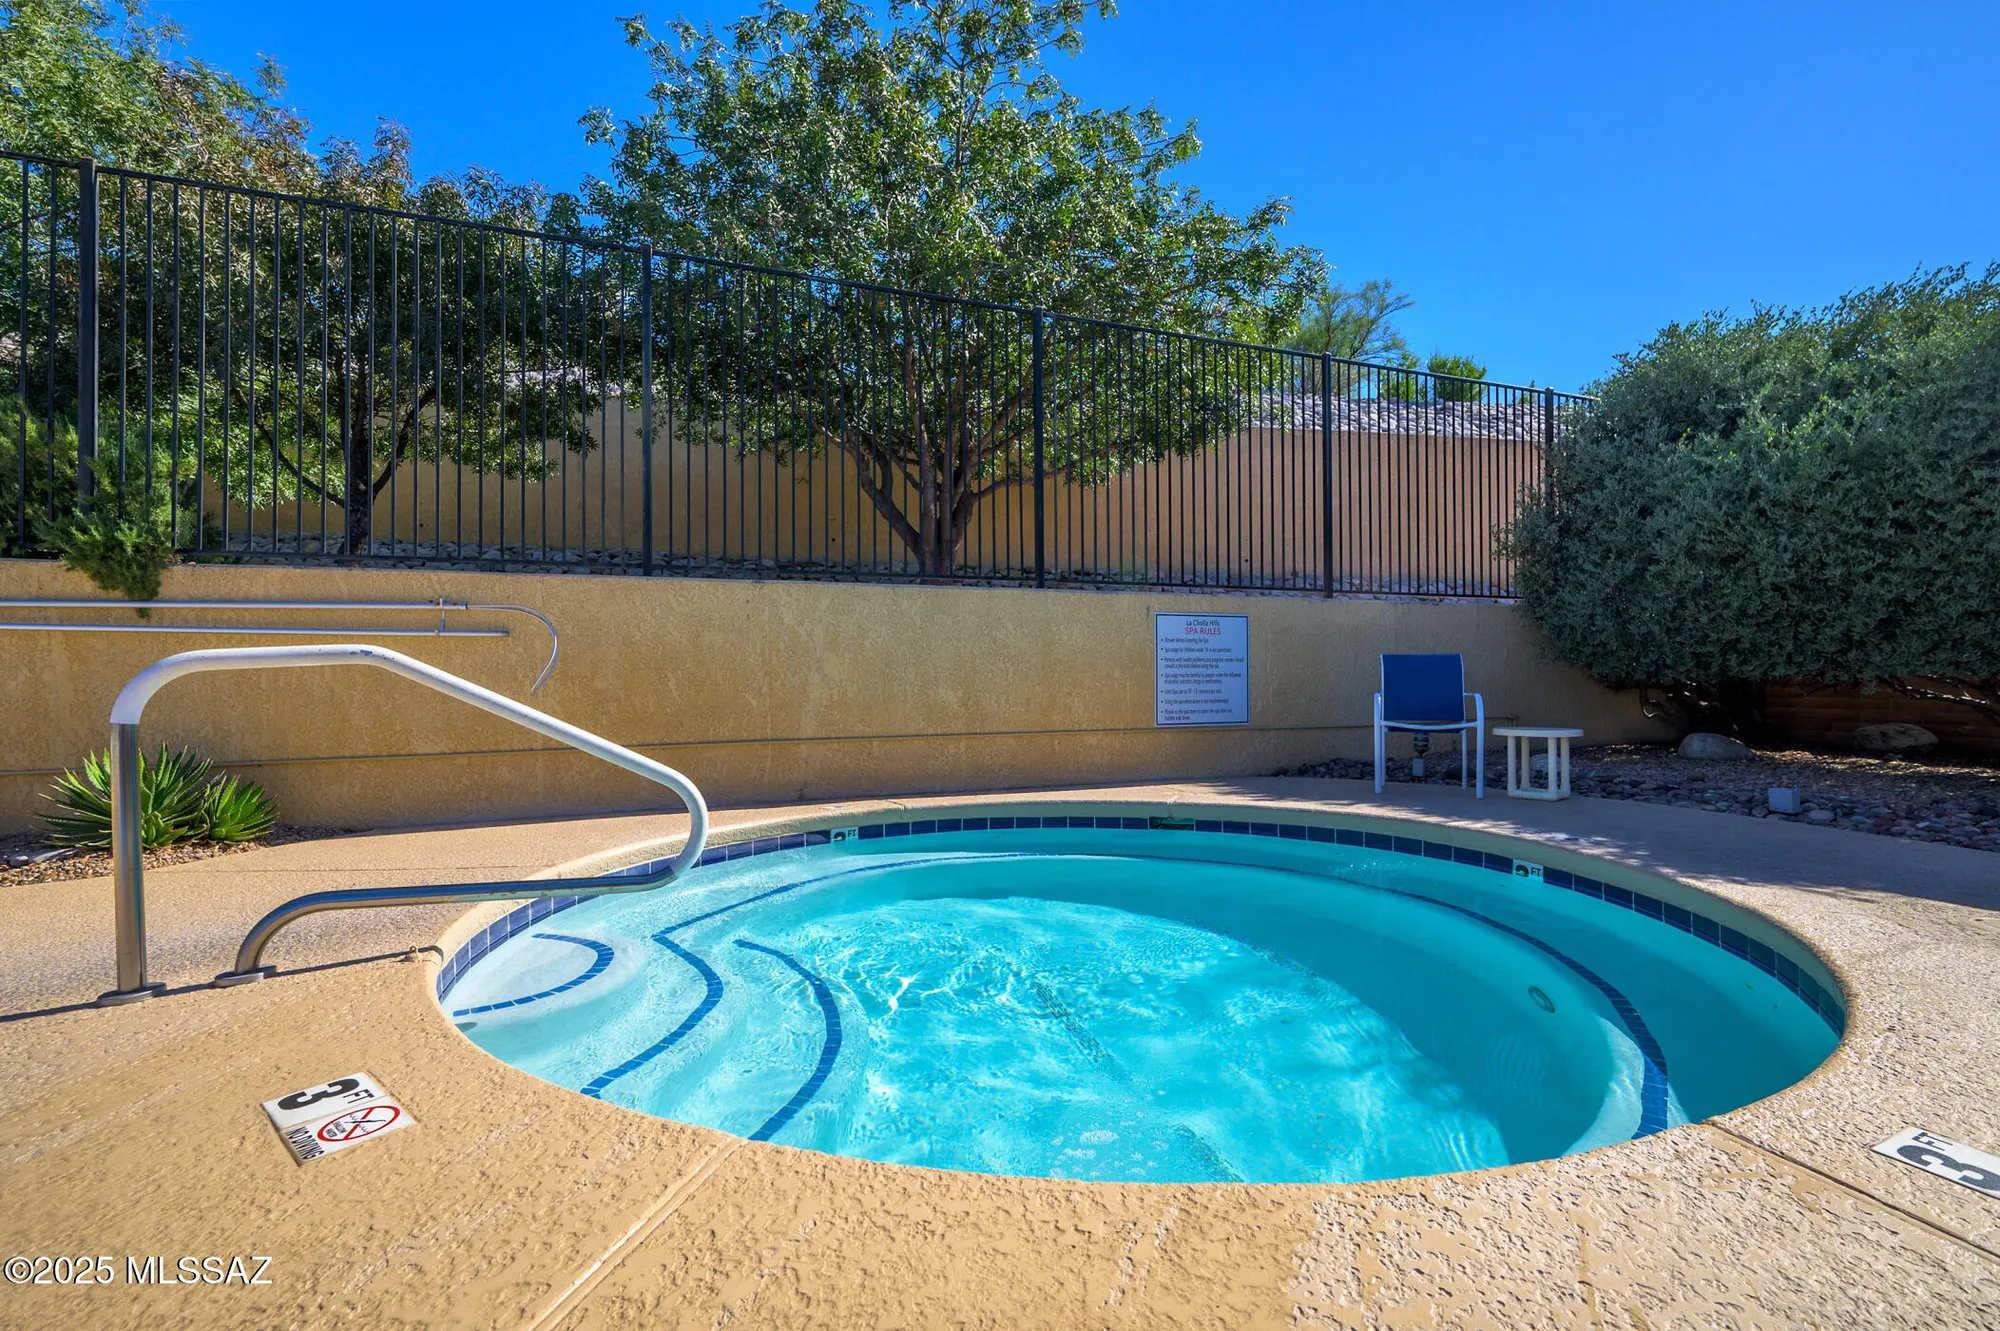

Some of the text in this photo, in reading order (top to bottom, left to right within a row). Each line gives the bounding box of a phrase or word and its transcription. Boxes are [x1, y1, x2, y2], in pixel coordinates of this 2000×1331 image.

[1184, 627, 1222, 636] SPA RULES
[277, 1078, 375, 1110] 3 FT
[285, 1126, 325, 1160] NO DIVING
[1896, 1131, 2000, 1191] 3 FT
